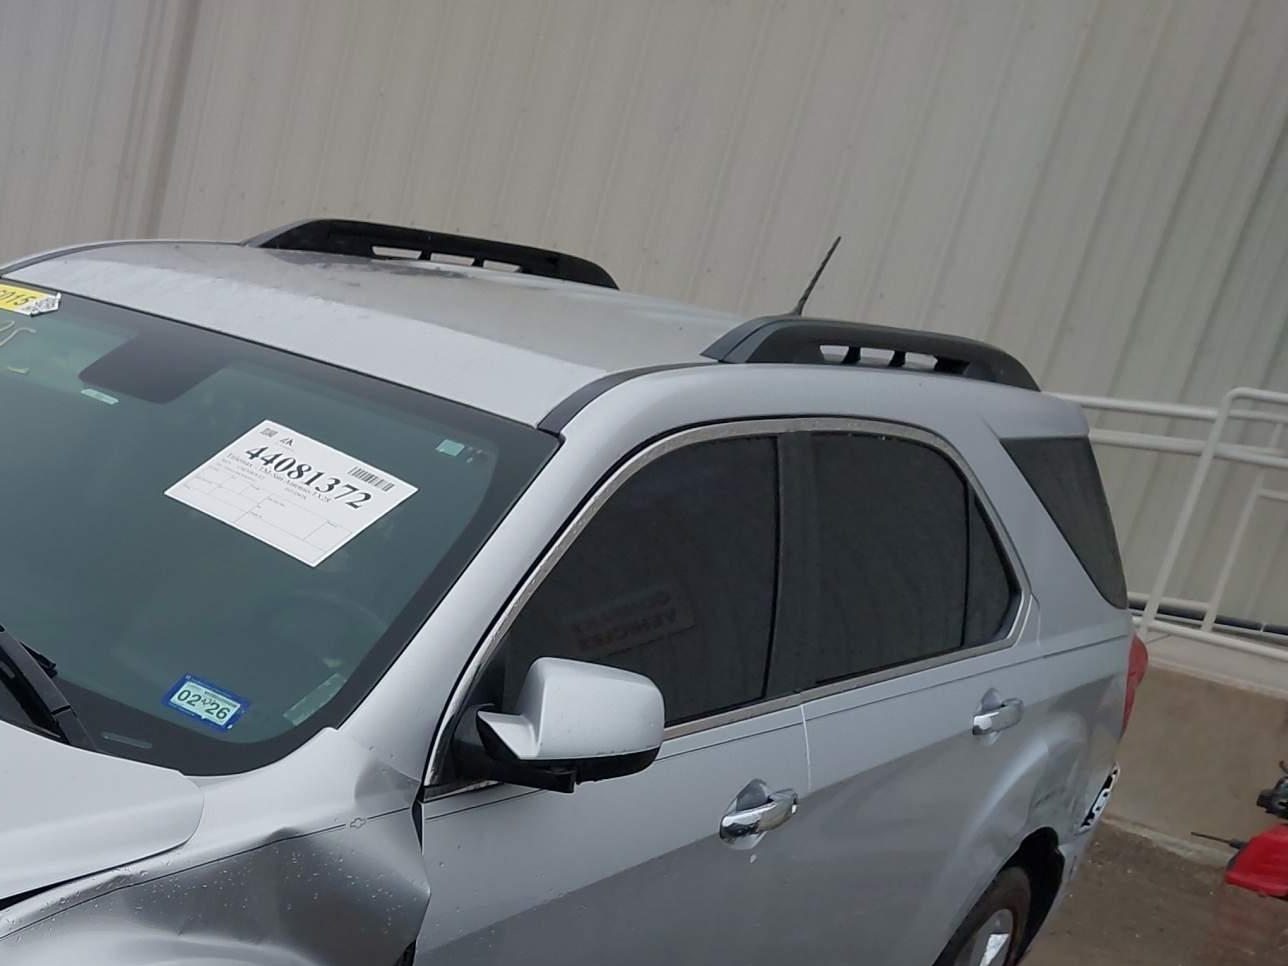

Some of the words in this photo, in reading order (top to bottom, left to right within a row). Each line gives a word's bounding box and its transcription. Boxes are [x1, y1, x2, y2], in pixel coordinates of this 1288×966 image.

[244, 445, 373, 510] 44081372
[176, 689, 202, 707] 02
[205, 702, 231, 720] 26
